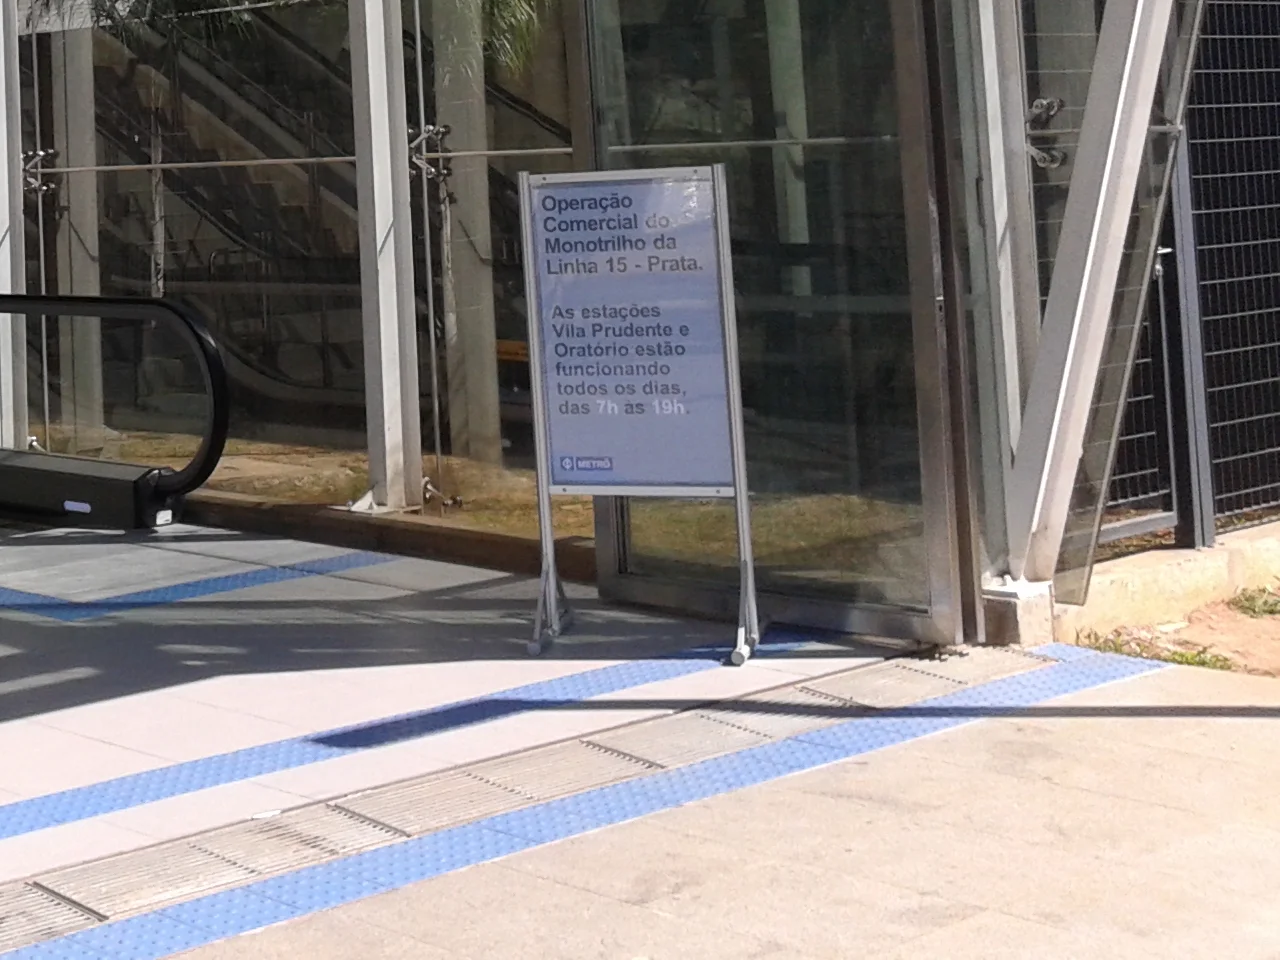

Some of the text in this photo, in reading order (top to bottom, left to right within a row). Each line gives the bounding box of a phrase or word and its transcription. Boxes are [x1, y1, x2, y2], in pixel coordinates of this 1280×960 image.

[541, 193, 633, 215] Operação
[543, 212, 670, 232] Comercial do
[545, 234, 677, 254] Monotrilho da
[546, 258, 598, 275] Linha
[606, 256, 627, 272] 15
[647, 255, 703, 272] Prata.
[552, 304, 661, 322] As estações
[552, 322, 690, 338] Vila Prudente e
[554, 340, 686, 358] Oratório estão
[555, 361, 671, 377] funcionando
[557, 380, 687, 397] todos os dias,
[558, 400, 590, 415] das
[596, 399, 618, 414] 7h
[652, 399, 691, 415] 19h.
